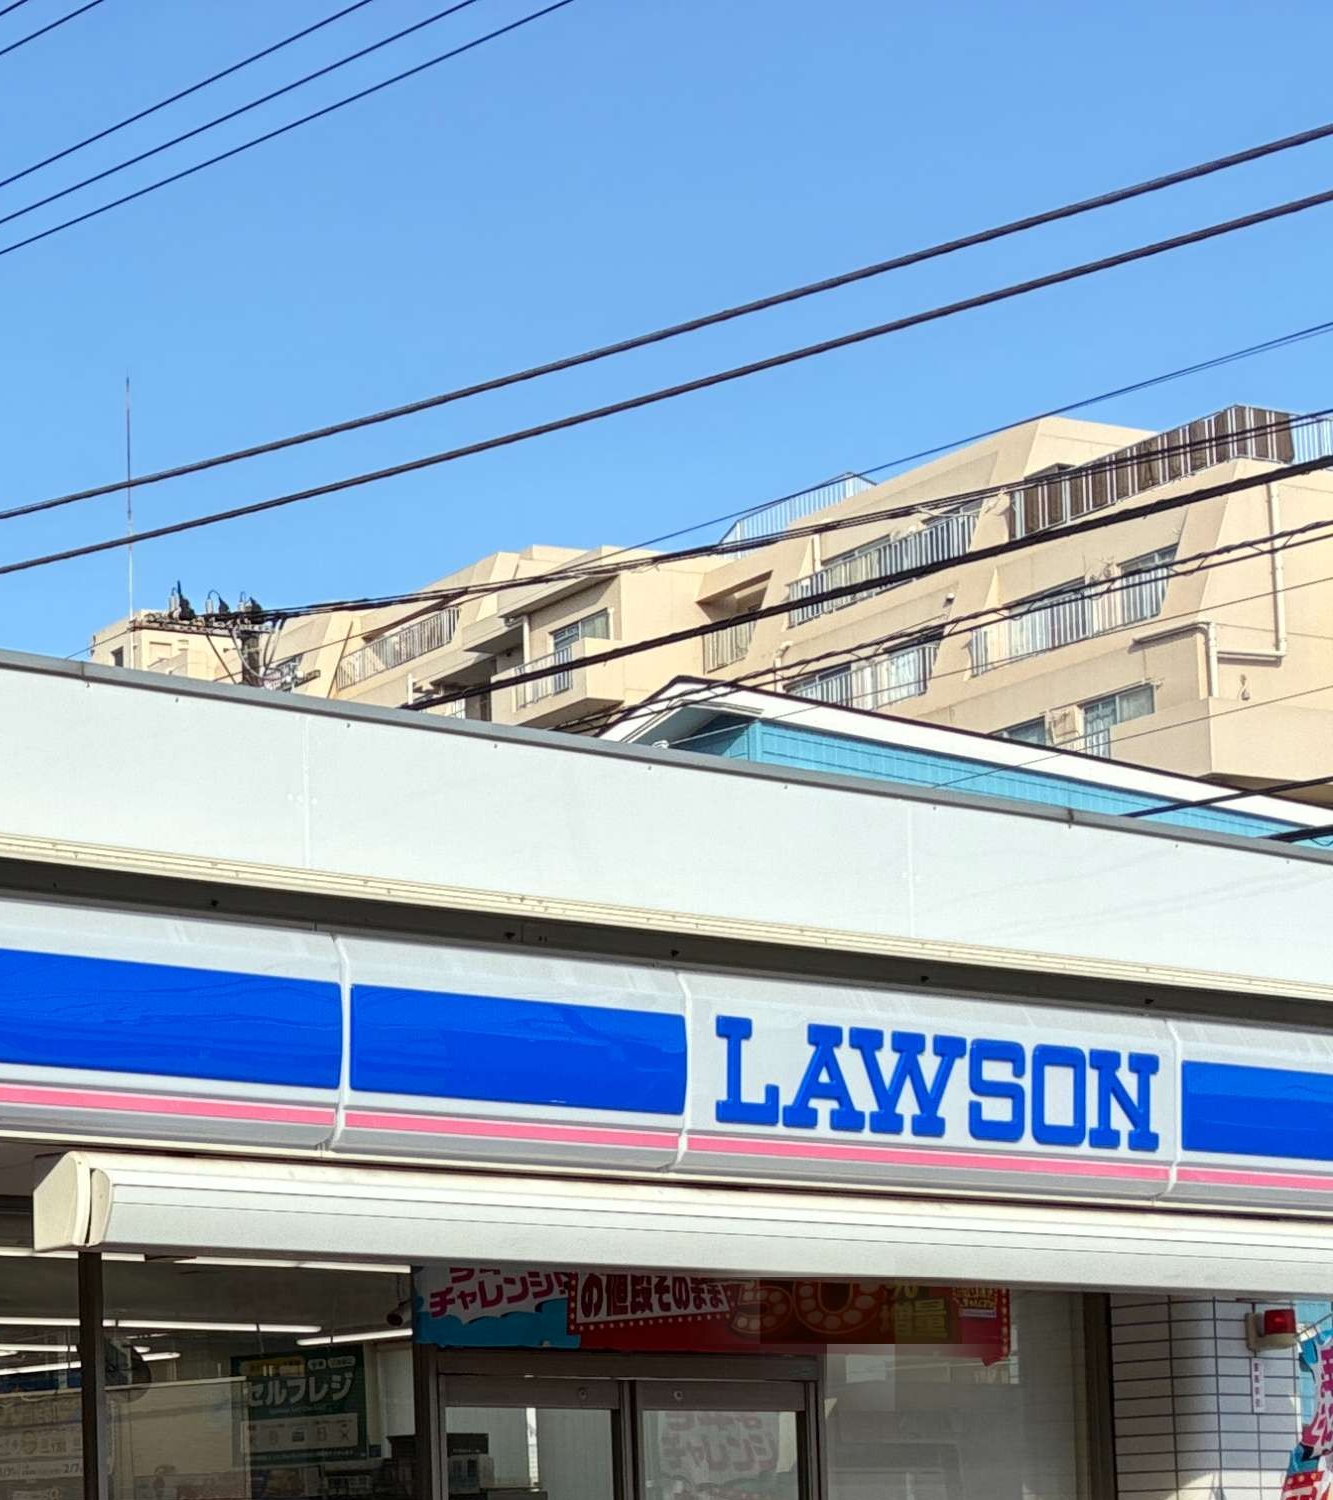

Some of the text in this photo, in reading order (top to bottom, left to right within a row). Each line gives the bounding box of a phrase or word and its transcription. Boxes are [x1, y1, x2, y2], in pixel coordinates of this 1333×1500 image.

[715, 1014, 1160, 1152] LAWSON
[244, 1370, 354, 1407] セルフレジ
